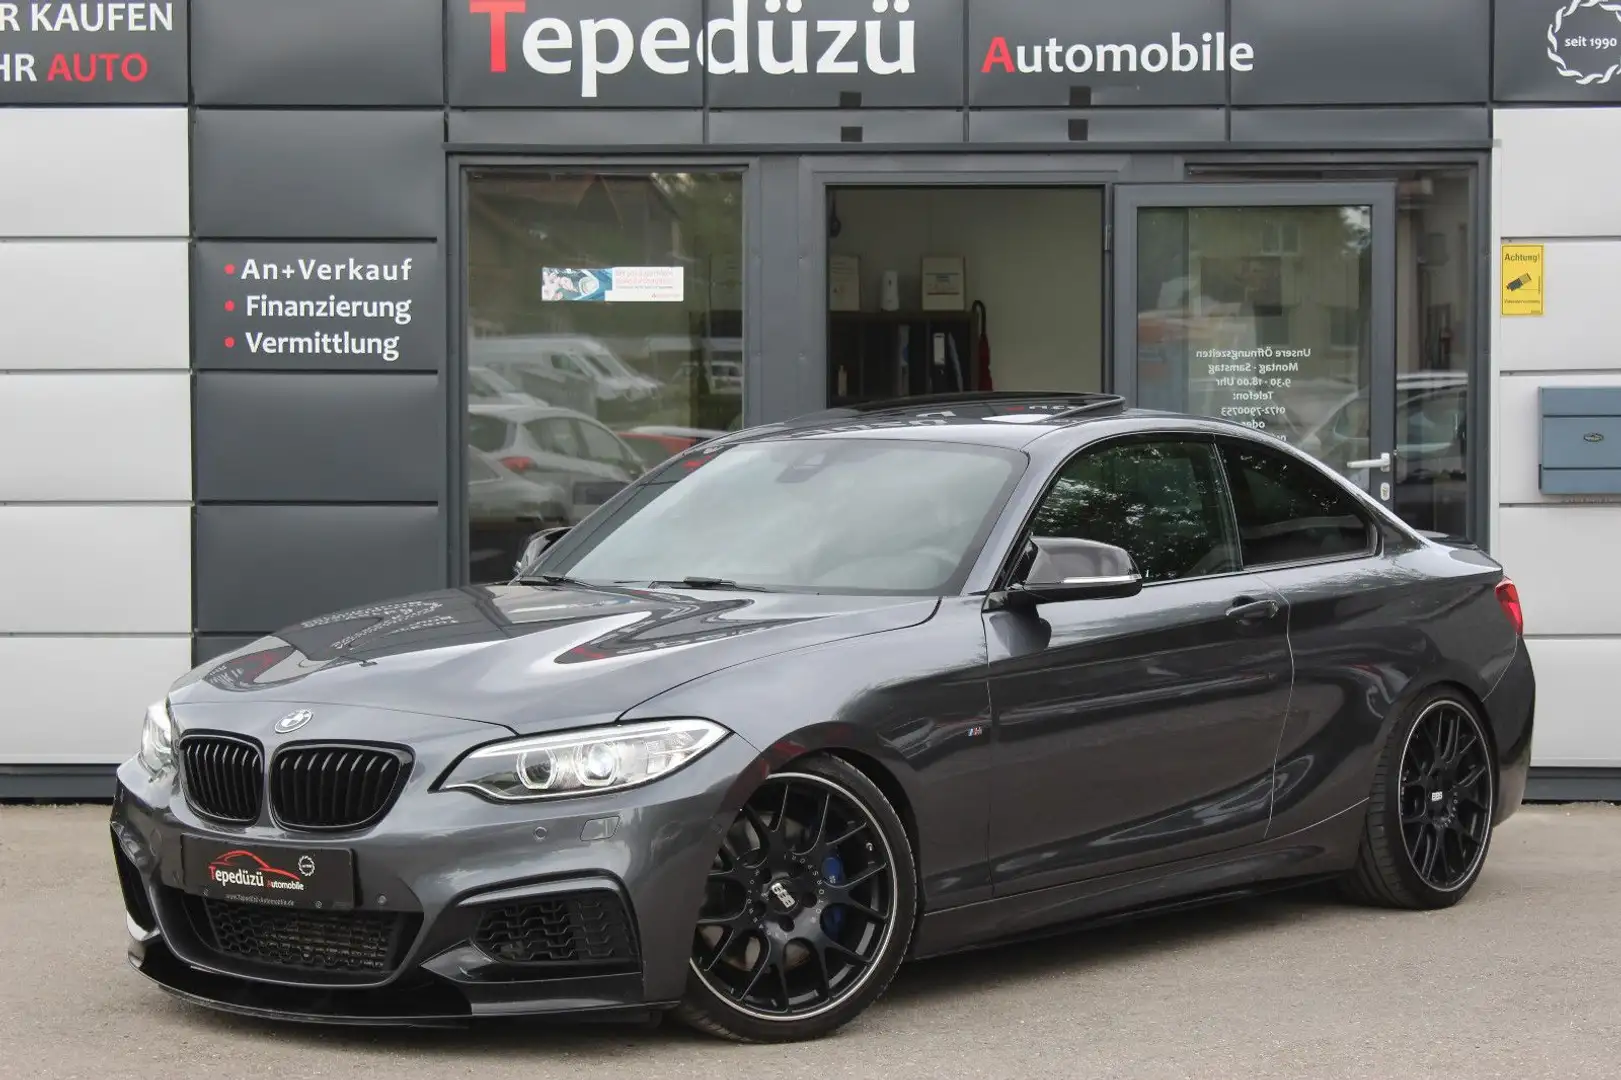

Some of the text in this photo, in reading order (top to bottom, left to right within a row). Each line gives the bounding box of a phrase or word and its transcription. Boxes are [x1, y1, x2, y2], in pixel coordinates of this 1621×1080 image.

[31, 3, 173, 31] KAUFEN
[469, 0, 1254, 97] Tepedüzü Automobile
[1564, 36, 1617, 50] seit 1990
[47, 52, 148, 82] AUTO
[241, 258, 412, 281] An+Verkauf
[246, 295, 412, 324] Finanzierung
[246, 332, 400, 361] Vermittlung
[208, 865, 305, 891] Tepedüzü Automobile
